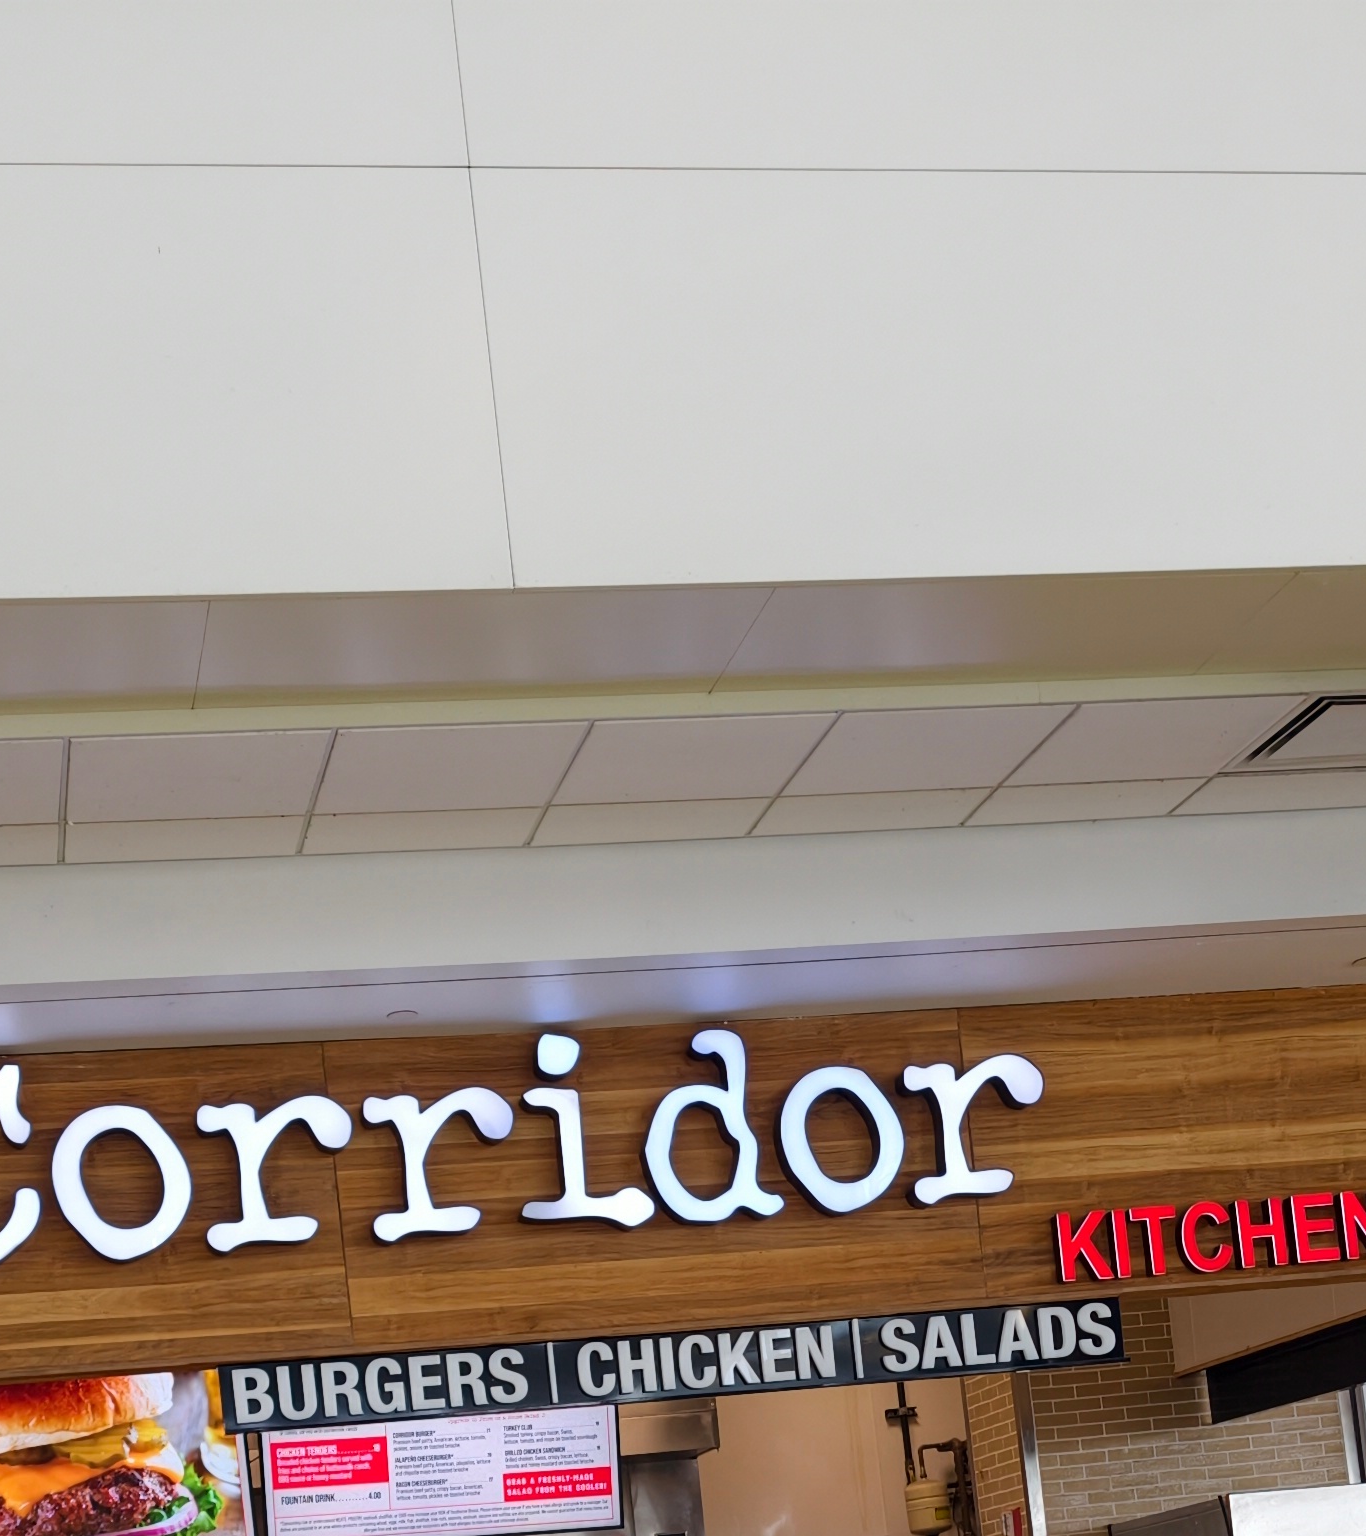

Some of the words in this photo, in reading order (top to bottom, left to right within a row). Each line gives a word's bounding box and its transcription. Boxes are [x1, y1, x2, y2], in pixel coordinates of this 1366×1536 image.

[230, 1347, 529, 1425] BURGERS
[577, 1325, 836, 1398] CHICKEN
[879, 1302, 1118, 1373] SALADS
